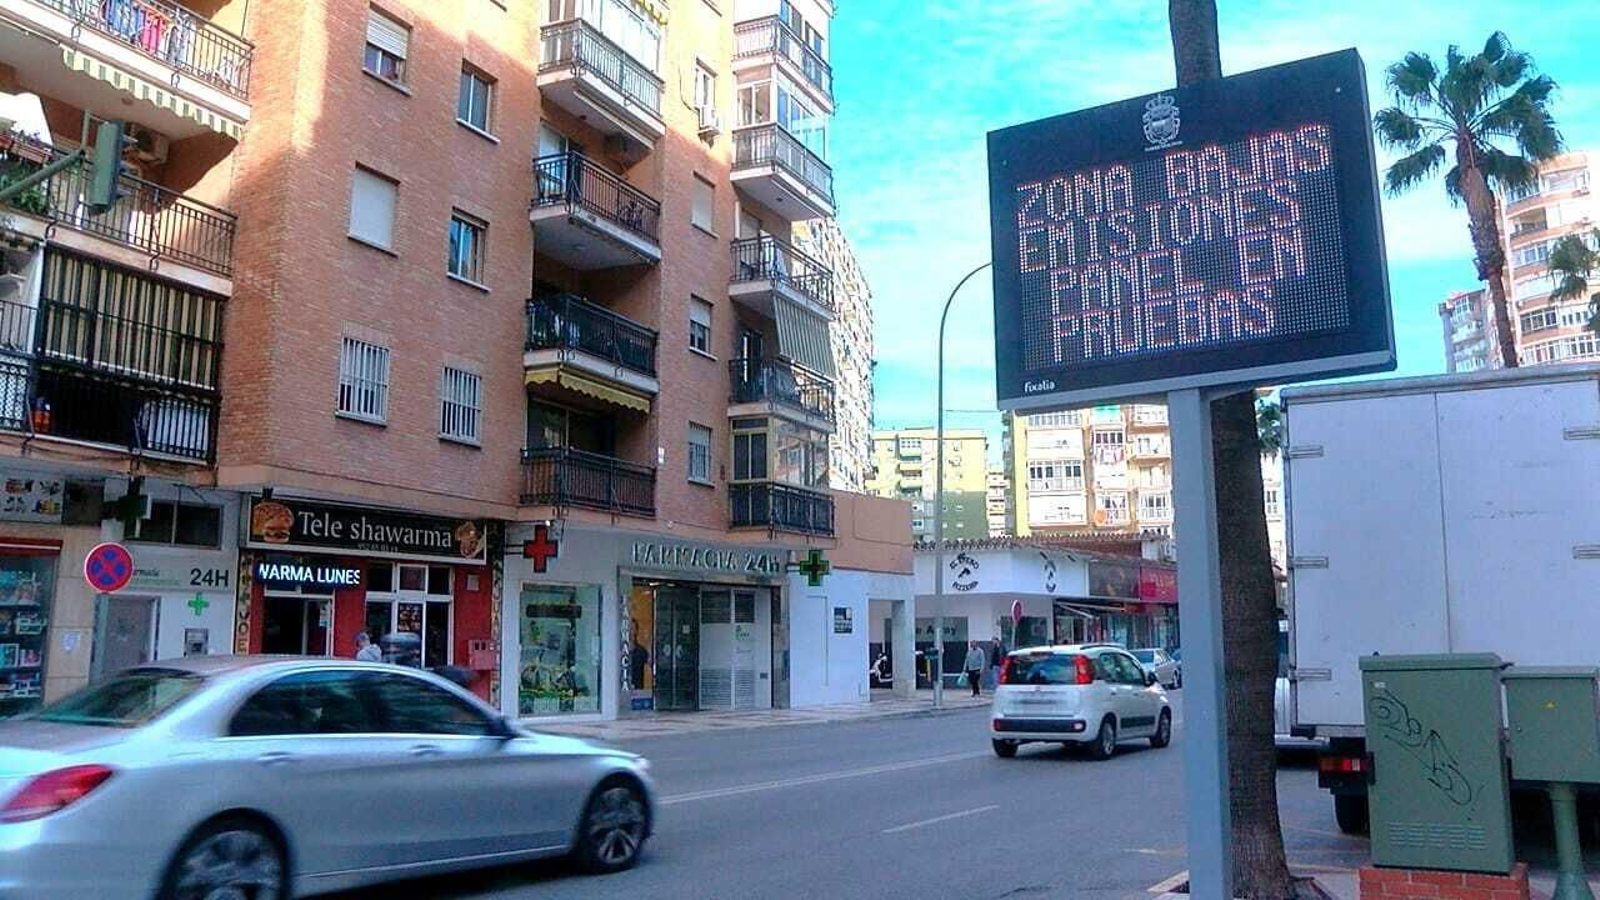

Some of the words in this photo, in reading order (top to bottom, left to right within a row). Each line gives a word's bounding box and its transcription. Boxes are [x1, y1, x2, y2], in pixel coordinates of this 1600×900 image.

[1016, 164, 1134, 229] ZONA
[1165, 124, 1329, 200] BAJAS
[1019, 179, 1299, 273] EMISIONES
[1050, 248, 1205, 316] PANEL
[1238, 227, 1305, 286] EN
[1052, 285, 1275, 363] PRUEBAS
[298, 511, 343, 539] Tele
[350, 516, 452, 548] shawarma
[632, 540, 738, 570] FARMACIA
[190, 568, 229, 587] 24H
[317, 566, 360, 585] LUNES
